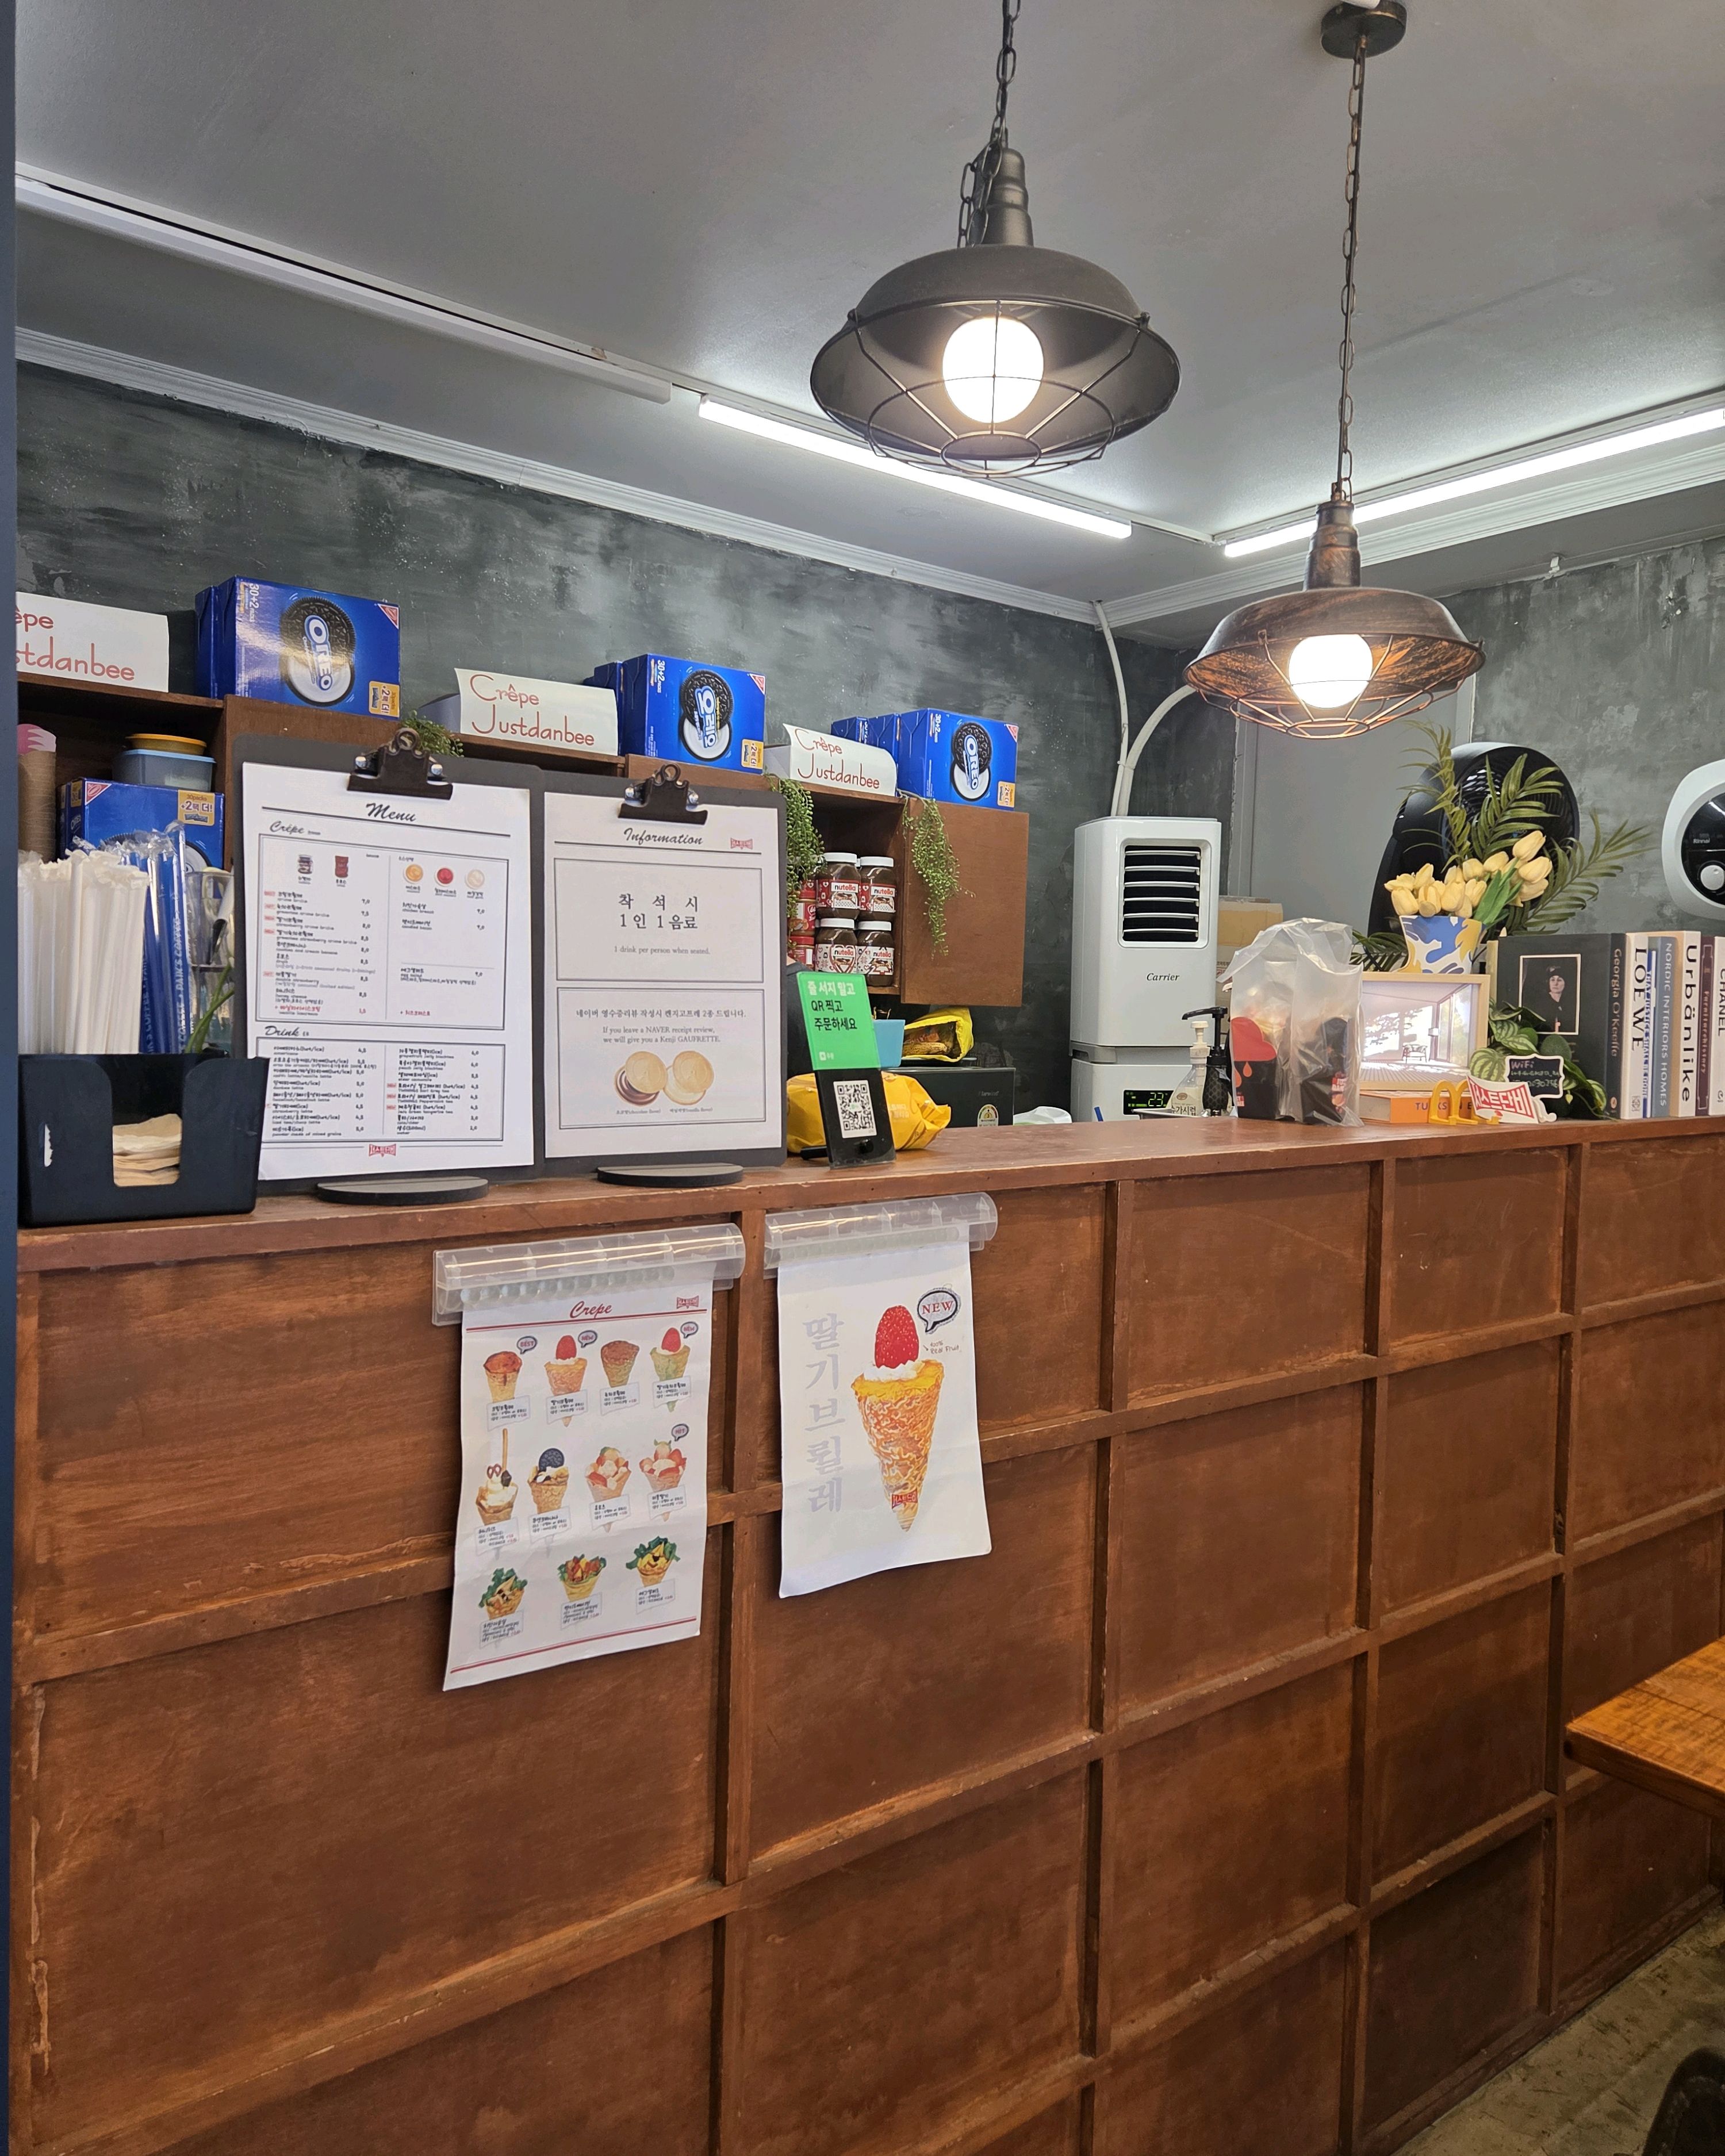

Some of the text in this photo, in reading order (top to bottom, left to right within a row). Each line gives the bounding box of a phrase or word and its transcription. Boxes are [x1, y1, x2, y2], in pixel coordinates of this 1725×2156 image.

[249, 582, 260, 609] 30+2
[308, 616, 332, 690] OREO
[657, 659, 665, 681] 30+2
[469, 674, 540, 708] Crêpe
[471, 705, 595, 747] Justdanbee
[696, 687, 717, 748] 오레오
[794, 728, 842, 755] Crêpe
[798, 753, 880, 789] Justdanbee
[965, 735, 979, 789] OREO
[201, 802, 213, 812] 더!
[365, 802, 417, 822] Menu
[623, 827, 703, 845] Information
[650, 947, 670, 956] person
[672, 946, 688, 954] when
[690, 946, 711, 954] seated.
[1147, 973, 1180, 981] Carrier
[1611, 948, 1622, 998] Georgia
[807, 981, 817, 995] 줄
[819, 981, 837, 996] 서지
[811, 1000, 844, 1013] QR 찍고
[1631, 947, 1647, 1052] LOEWE
[264, 1025, 300, 1037] Drink
[672, 1027, 692, 1035] receipt
[814, 1017, 857, 1031] 주문하세요
[1659, 943, 1672, 1107] NORDIC INTERIORS HOMES
[1682, 945, 1697, 1102] Urbänlike
[627, 1036, 640, 1045] give
[660, 1036, 676, 1044] Kenji
[1511, 1061, 1535, 1069] WiFi
[1148, 1092, 1164, 1107] 23
[569, 1300, 612, 1319] Crepe
[922, 1300, 954, 1315] NEW
[520, 1339, 535, 1347] BEST
